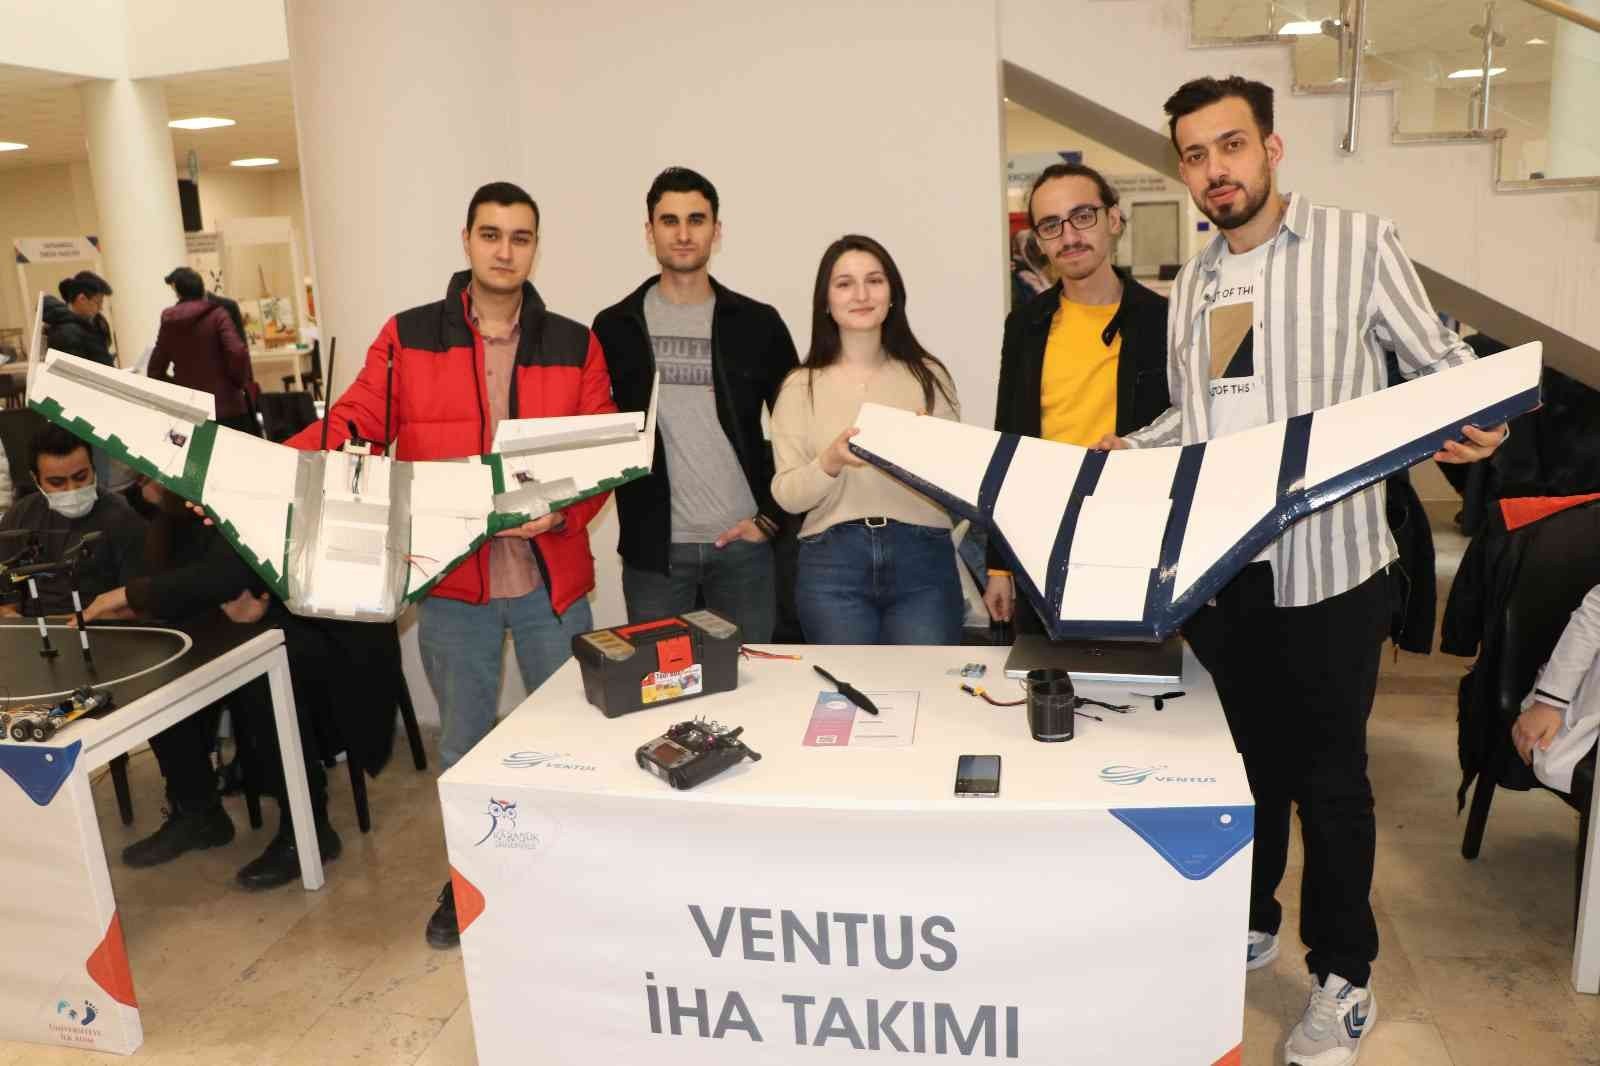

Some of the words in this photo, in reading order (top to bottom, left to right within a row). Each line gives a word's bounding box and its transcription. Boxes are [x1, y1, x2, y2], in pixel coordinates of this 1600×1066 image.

[1222, 287, 1235, 299] OF
[1237, 285, 1254, 296] THI
[687, 904, 959, 972] VENTUS
[645, 971, 764, 1042] İHA
[781, 993, 1019, 1059] TAKIMI
